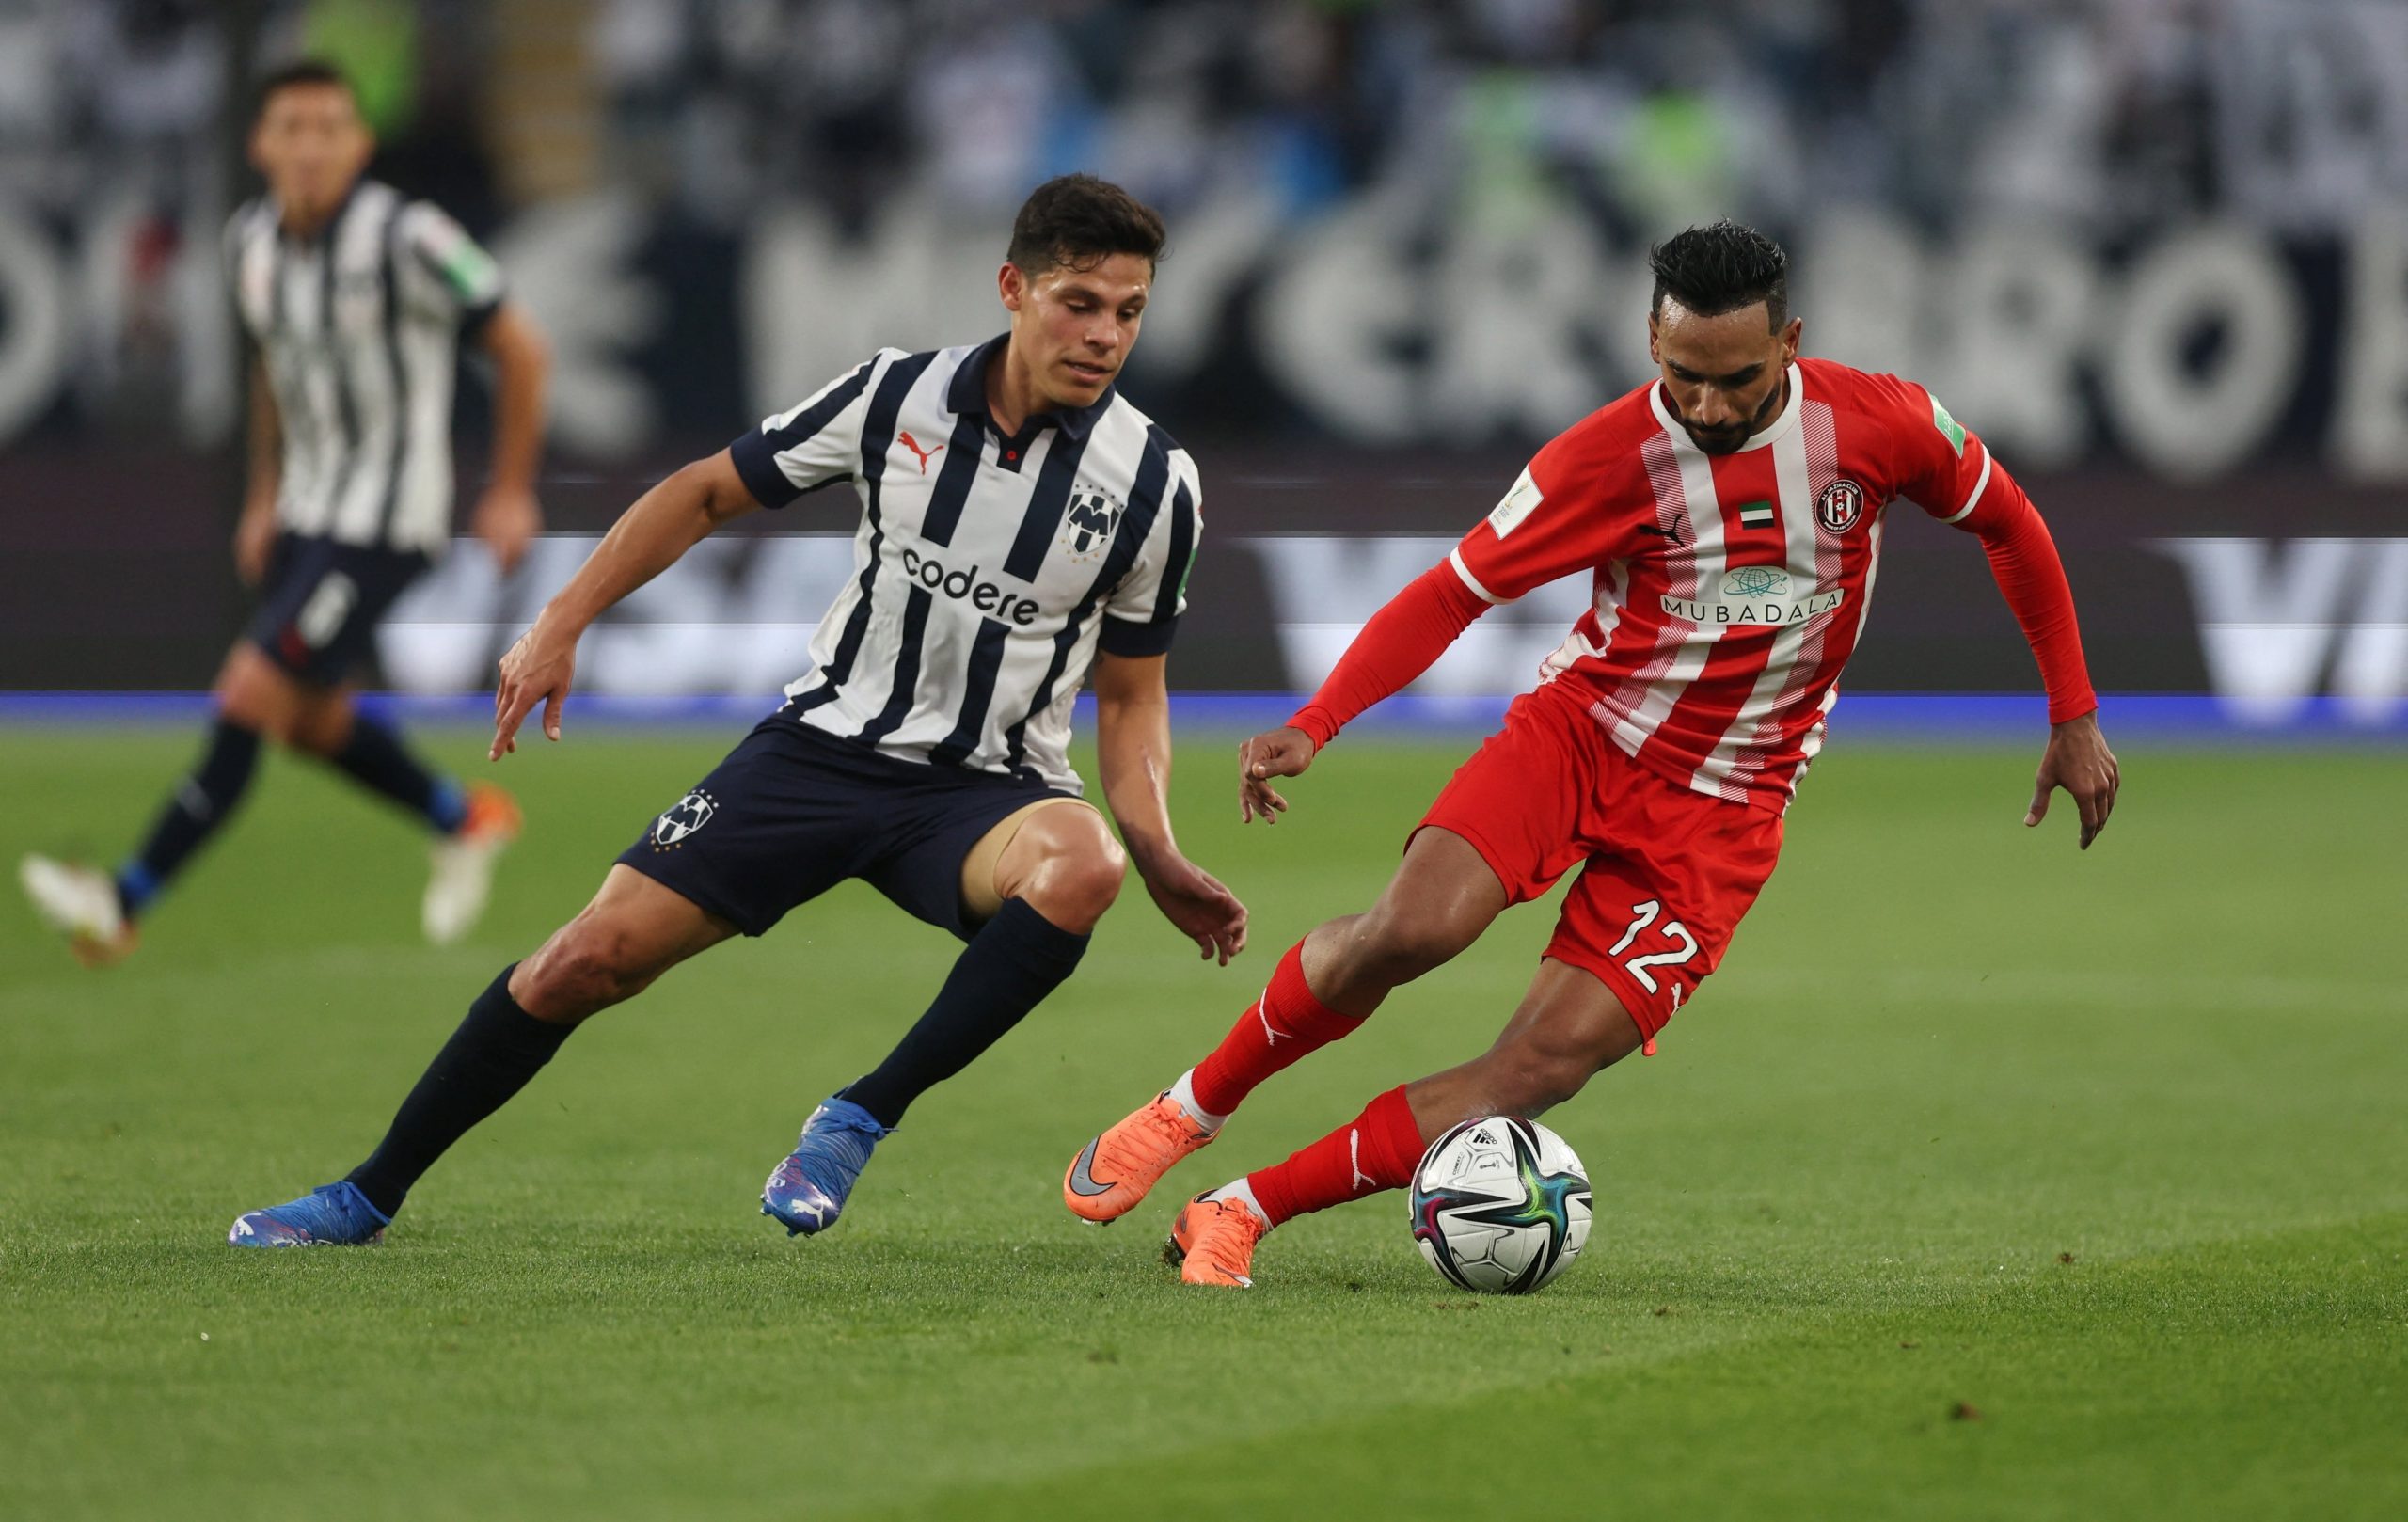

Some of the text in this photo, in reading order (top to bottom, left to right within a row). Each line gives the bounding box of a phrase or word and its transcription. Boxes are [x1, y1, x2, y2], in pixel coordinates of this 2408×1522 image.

[1846, 484, 1859, 495] CLUB
[903, 548, 1039, 626] codere
[1663, 593, 1837, 623] MUBADALA
[1608, 898, 1699, 996] 12
[1480, 1128, 1497, 1144] adidas
